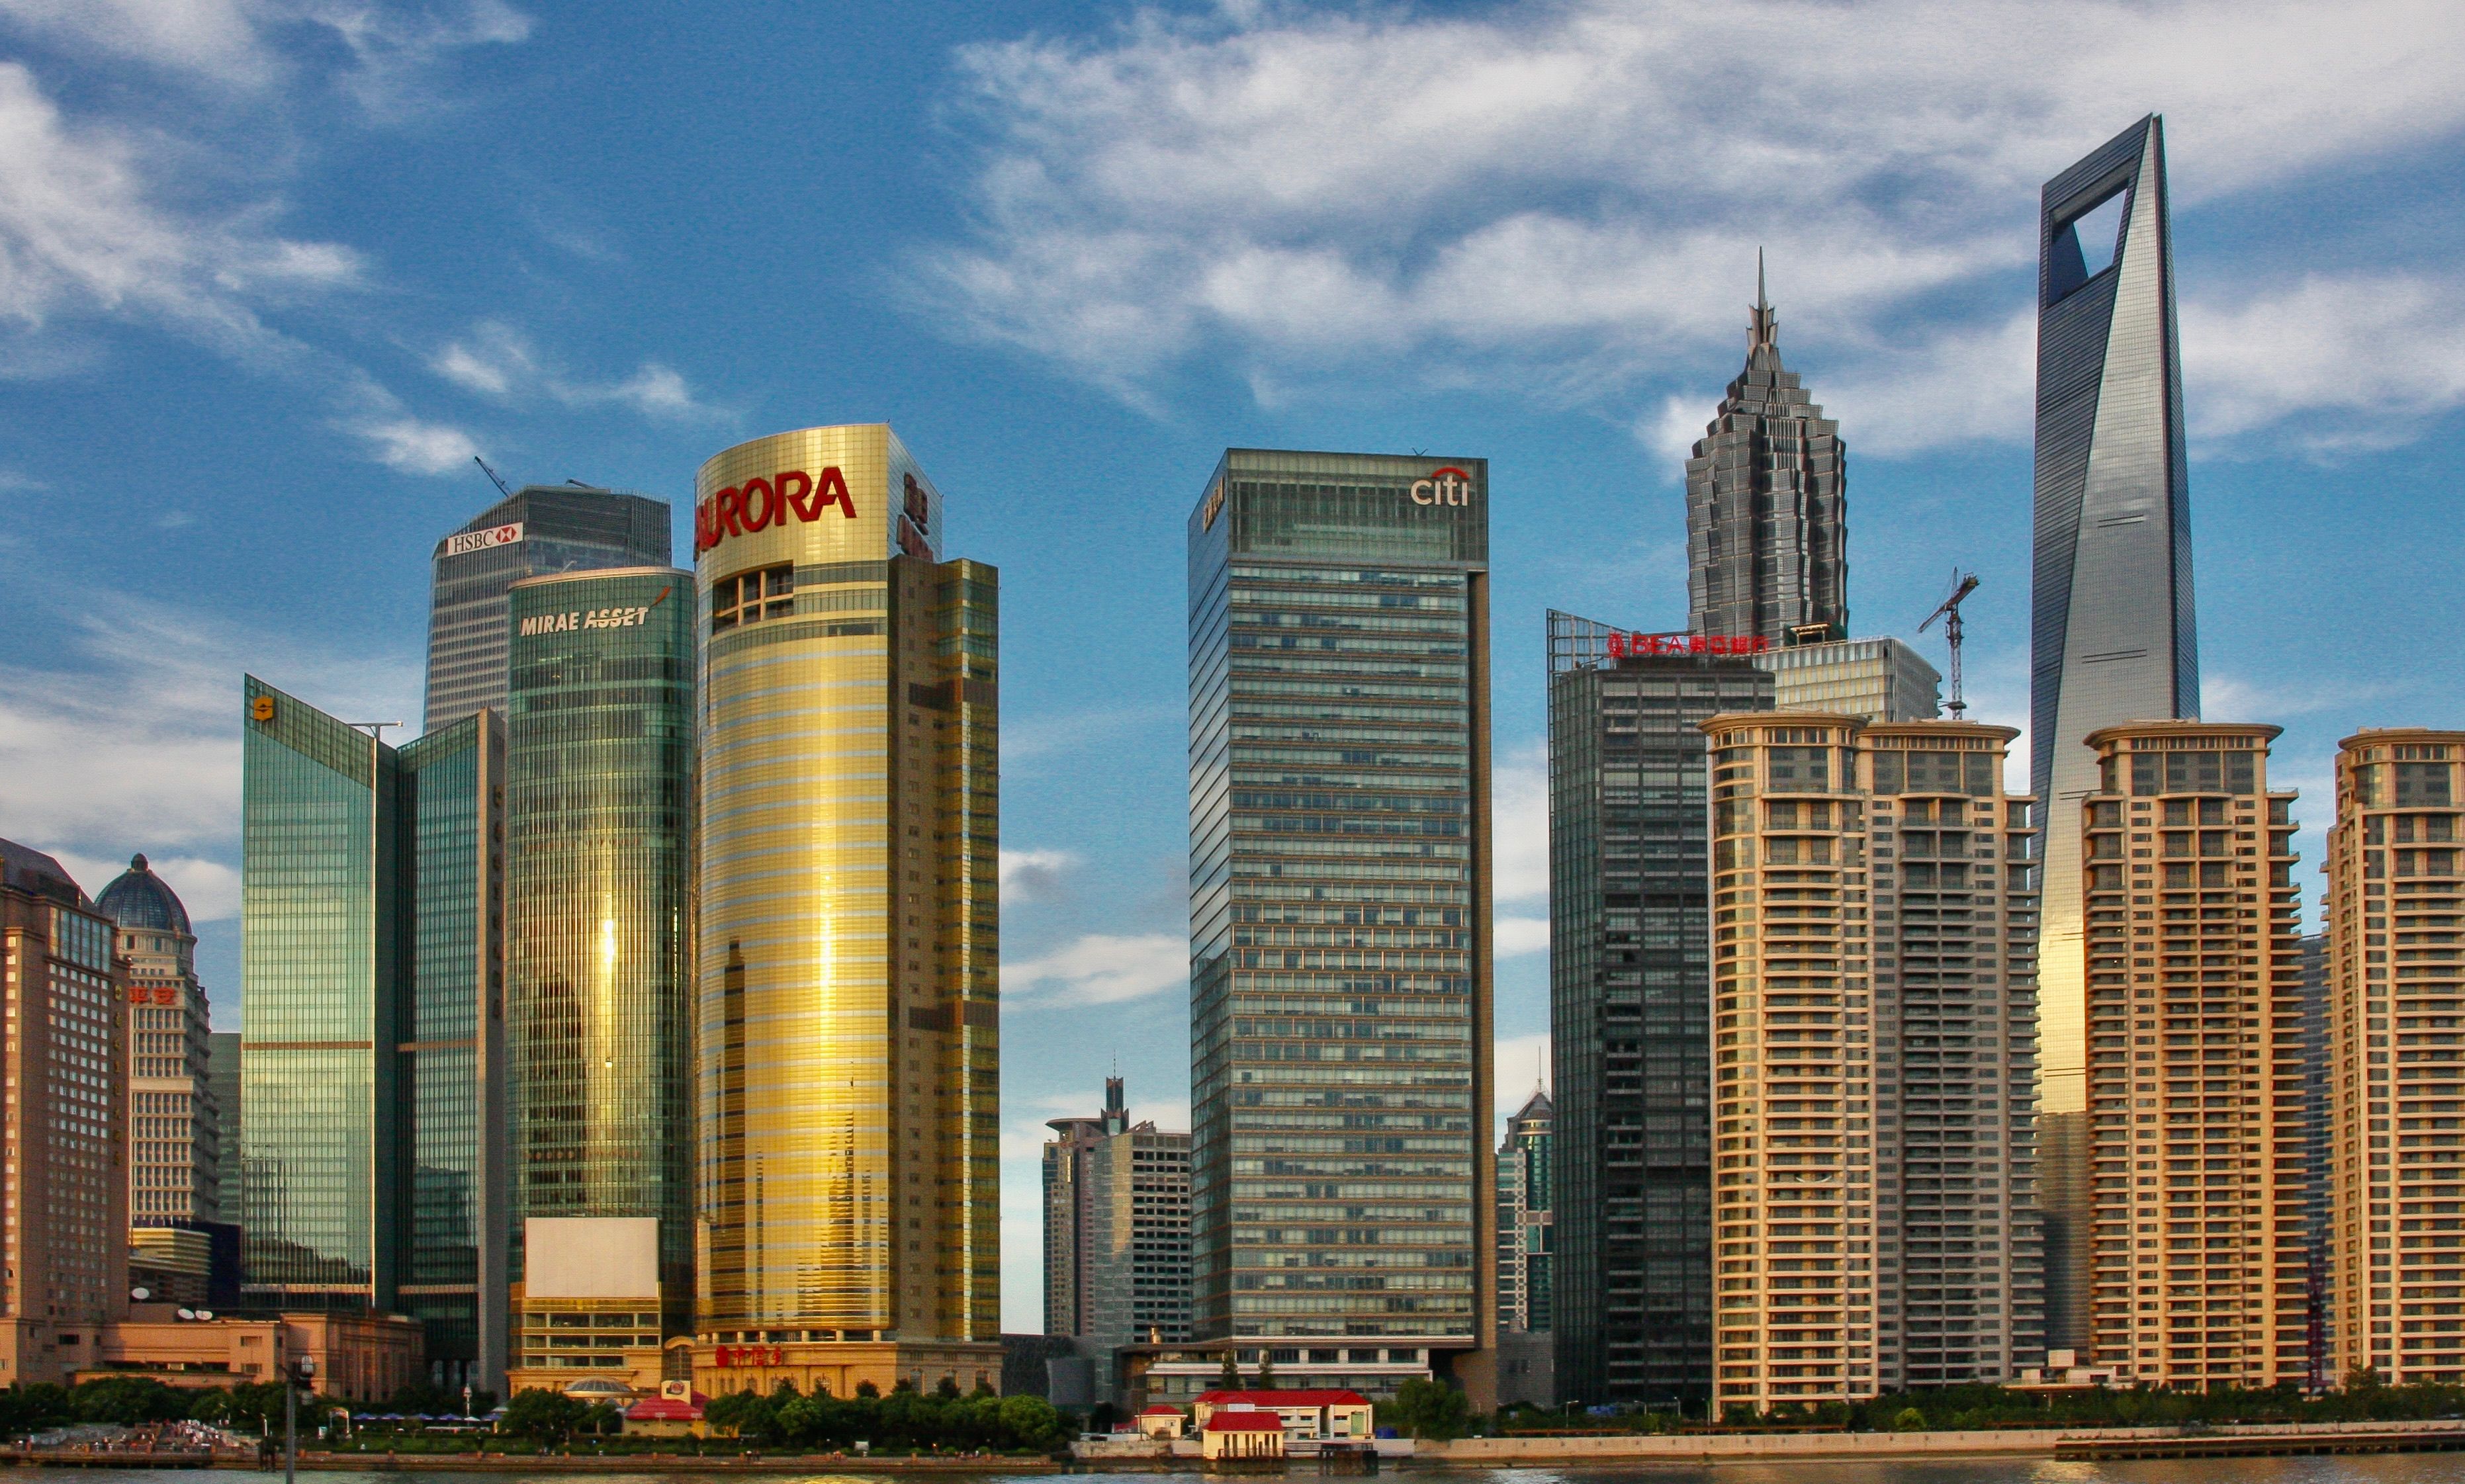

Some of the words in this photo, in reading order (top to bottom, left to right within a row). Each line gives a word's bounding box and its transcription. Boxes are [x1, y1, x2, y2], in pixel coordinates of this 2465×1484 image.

[1410, 474, 1468, 506] citi
[454, 531, 494, 553] HSBC
[520, 611, 580, 636] MIRAE
[584, 607, 649, 629] ASSET
[1631, 634, 1685, 654] BEA
